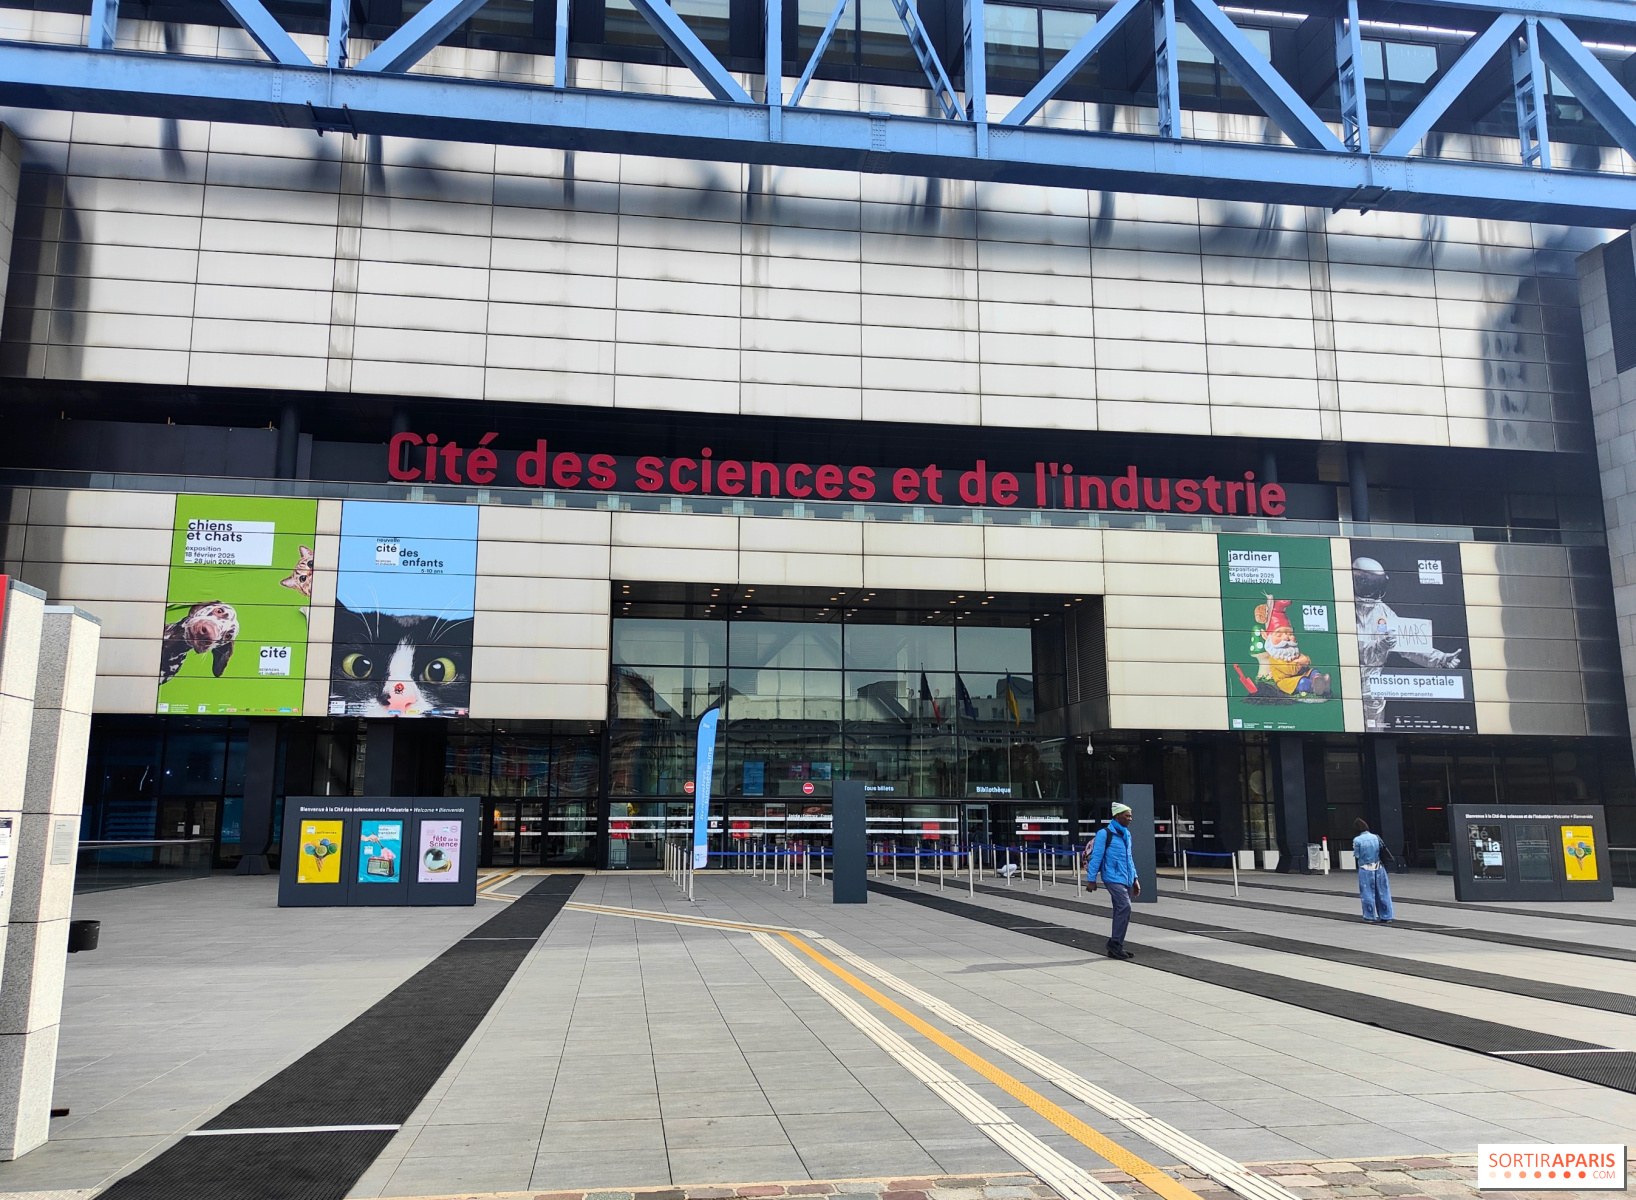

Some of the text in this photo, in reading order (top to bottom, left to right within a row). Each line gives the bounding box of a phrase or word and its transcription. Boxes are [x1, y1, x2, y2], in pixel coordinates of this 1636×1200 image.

[388, 432, 1286, 515] Cité des sciences et de l'industrie
[188, 519, 233, 531] chiens
[187, 531, 243, 542] et chats
[376, 543, 419, 557] cité des
[402, 557, 444, 568] enfants
[1229, 550, 1272, 563] jardiner
[1418, 560, 1439, 570] cité
[1303, 604, 1324, 616] cité
[1398, 623, 1428, 647] MARS
[260, 646, 287, 658] cité
[1370, 675, 1455, 688] mission spatiale
[976, 786, 1012, 794] Bibliothèque
